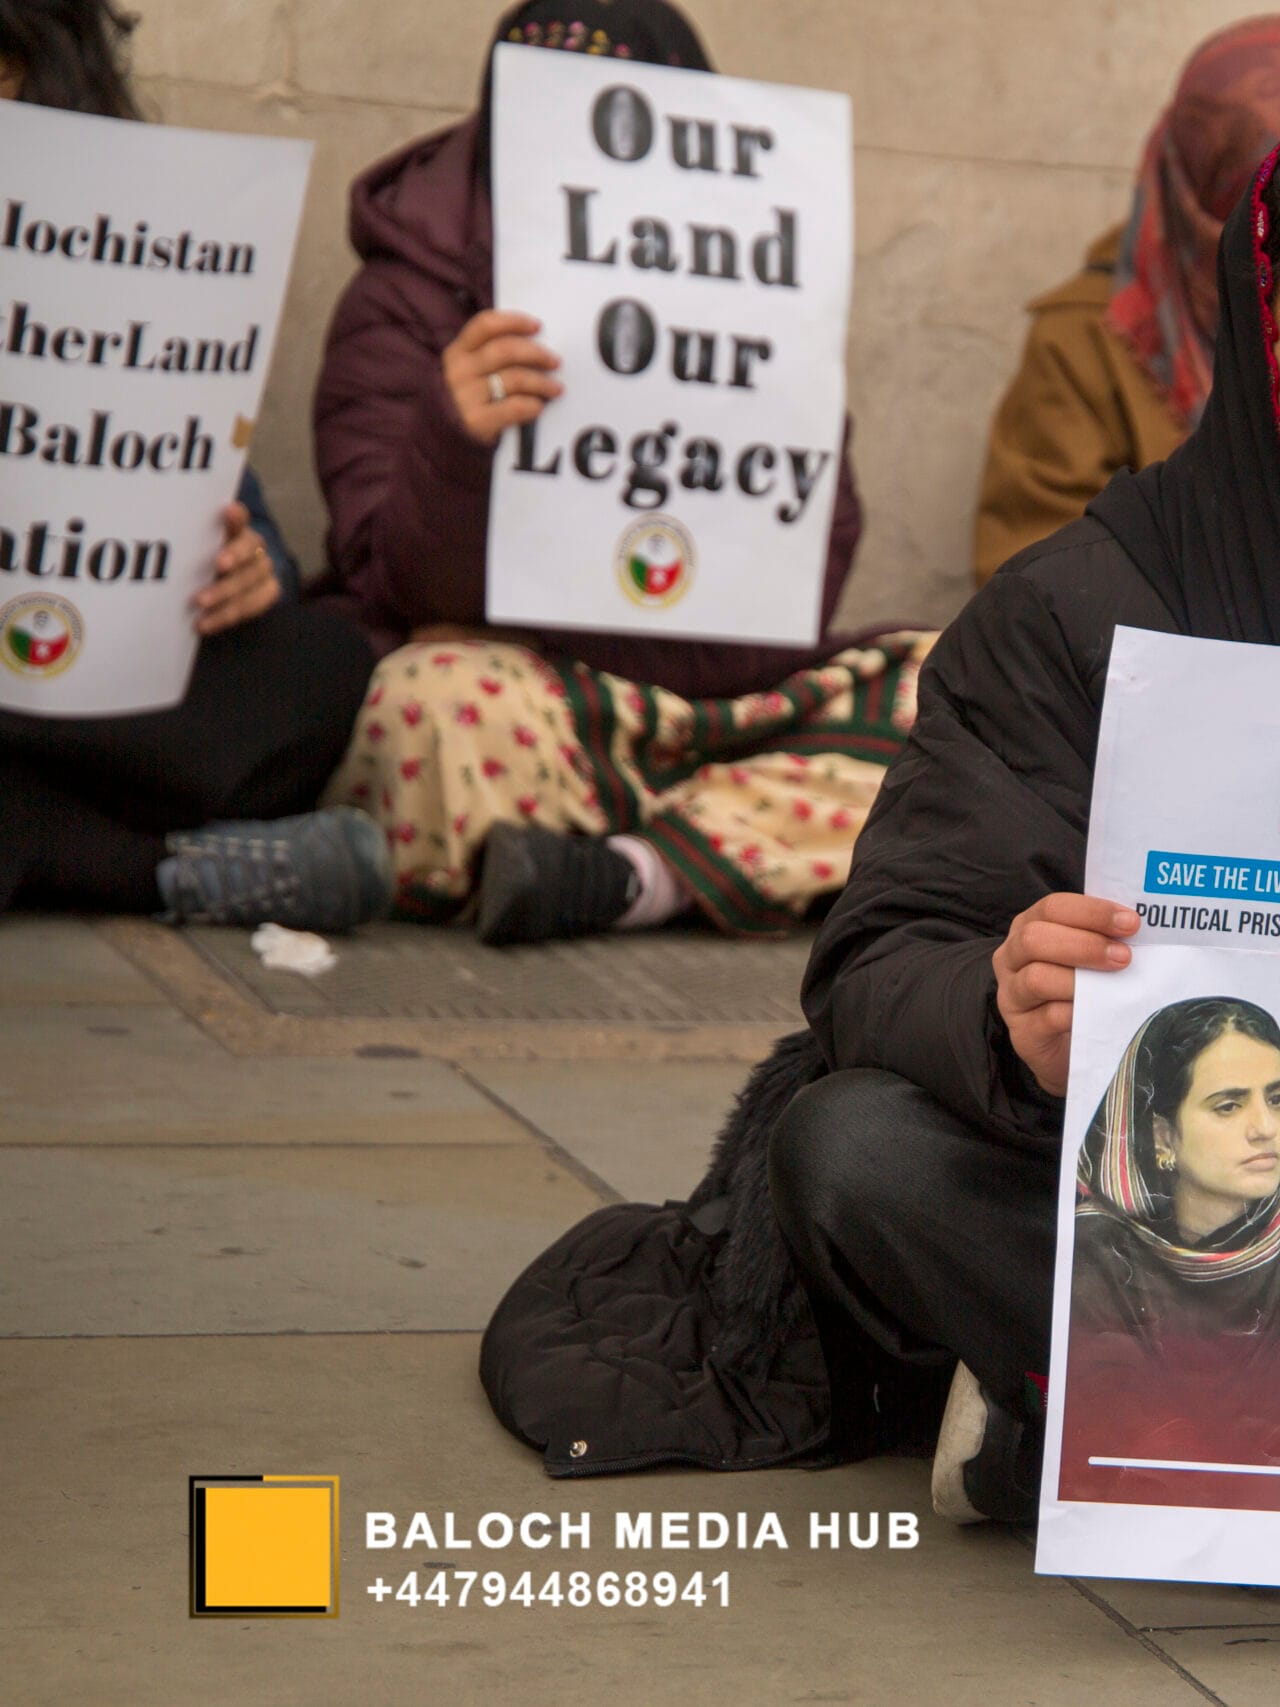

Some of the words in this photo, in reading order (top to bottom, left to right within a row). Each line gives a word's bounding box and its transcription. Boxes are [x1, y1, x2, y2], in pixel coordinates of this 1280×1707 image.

[590, 83, 775, 178] Our
[559, 185, 800, 288] Land
[0, 301, 260, 374] herLand
[594, 297, 772, 389] Our
[0, 402, 217, 472] Baloch
[512, 418, 833, 524] Legacy
[1156, 861, 1207, 888] SAVE
[1213, 865, 1250, 891] THE
[1135, 902, 1232, 933] POLITICAL
